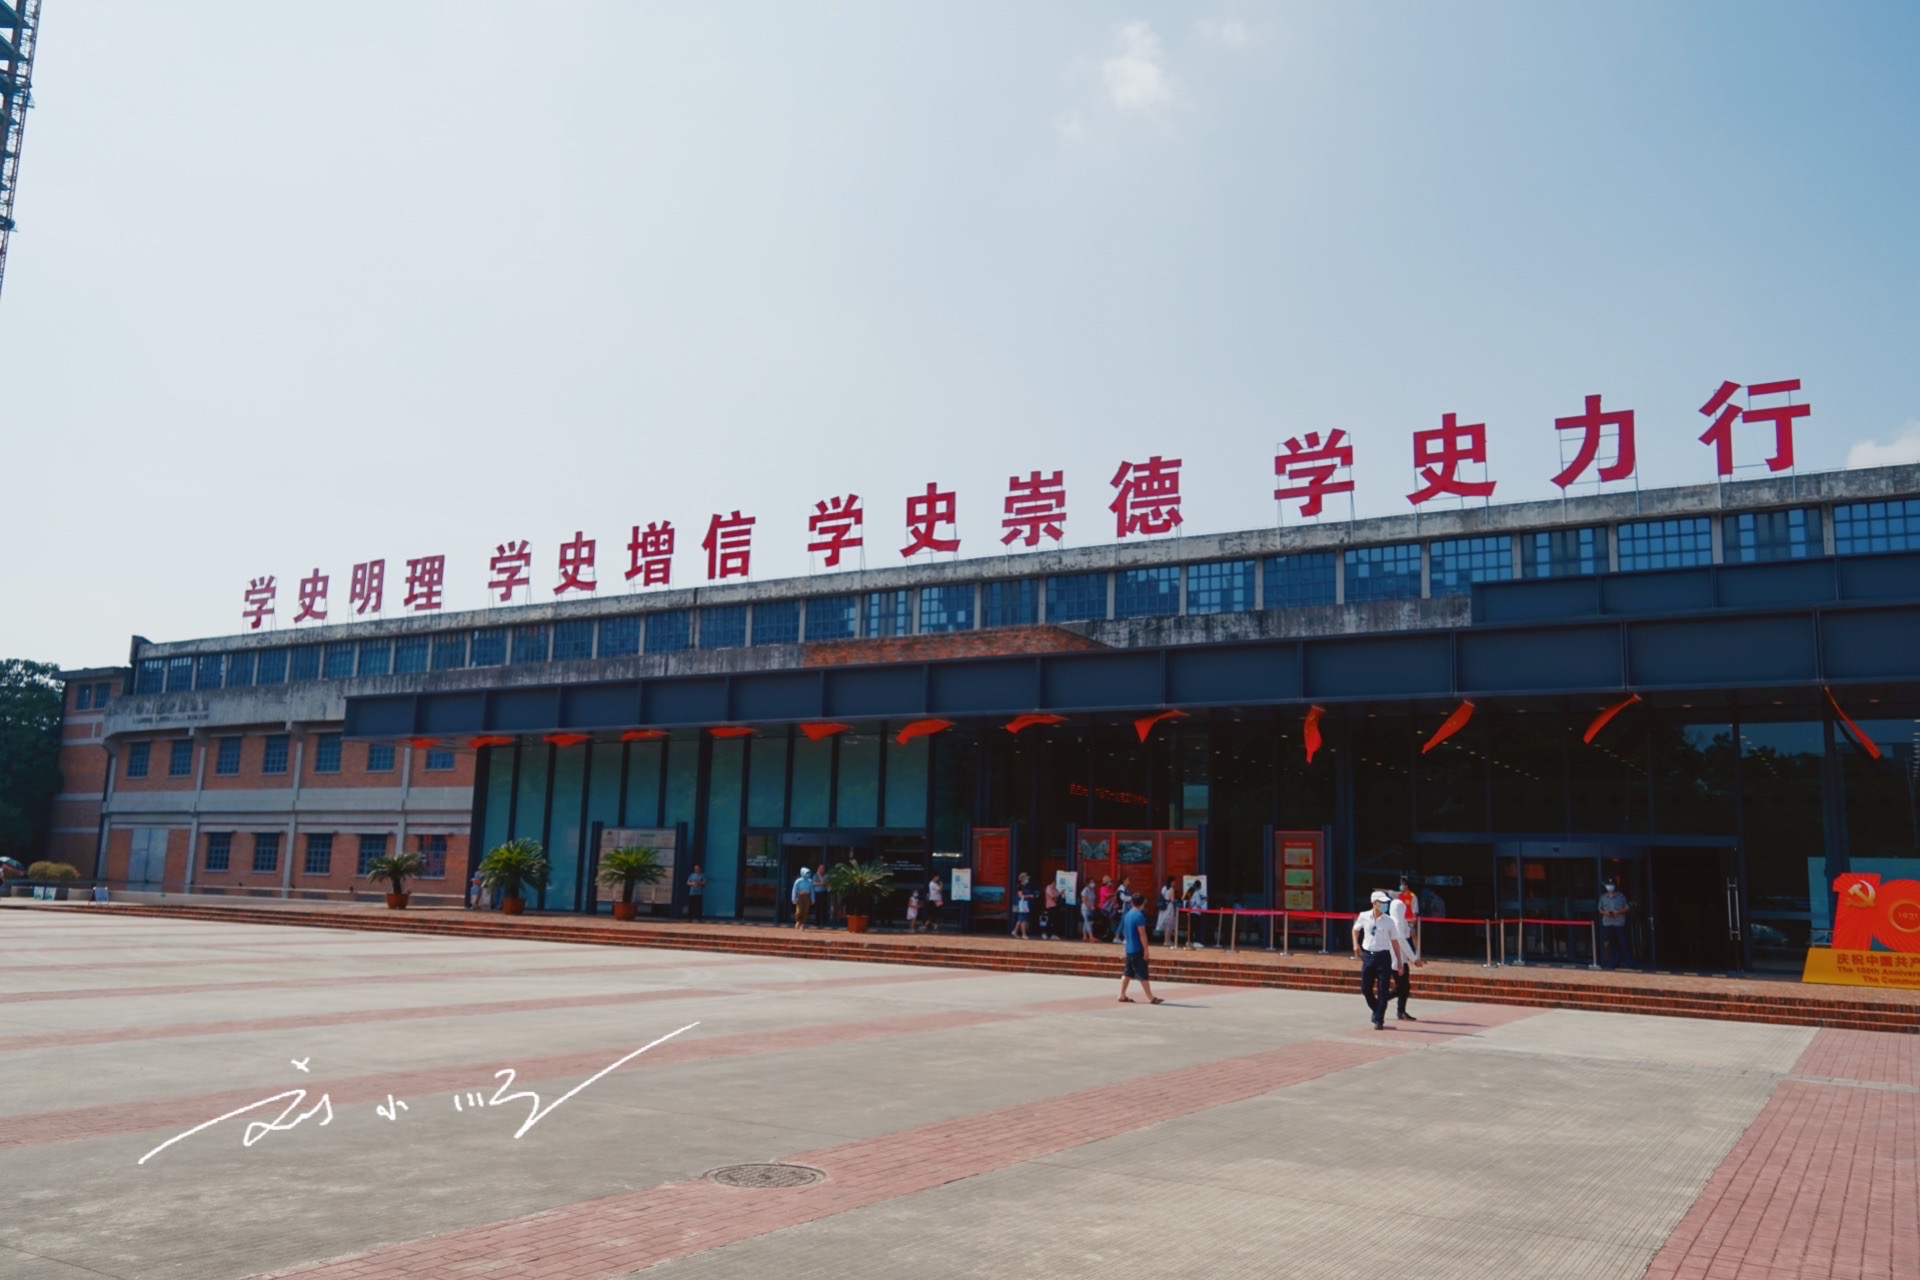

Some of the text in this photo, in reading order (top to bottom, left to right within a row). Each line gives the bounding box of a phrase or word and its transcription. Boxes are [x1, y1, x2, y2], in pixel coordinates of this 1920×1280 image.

[243, 379, 1810, 629] 学史明理 学史增信 学史崇德 学史力行
[1898, 912, 1918, 920] 1921
[1837, 966, 1853, 974] The
[1856, 967, 1879, 975] 100th
[1863, 975, 1879, 984] The
